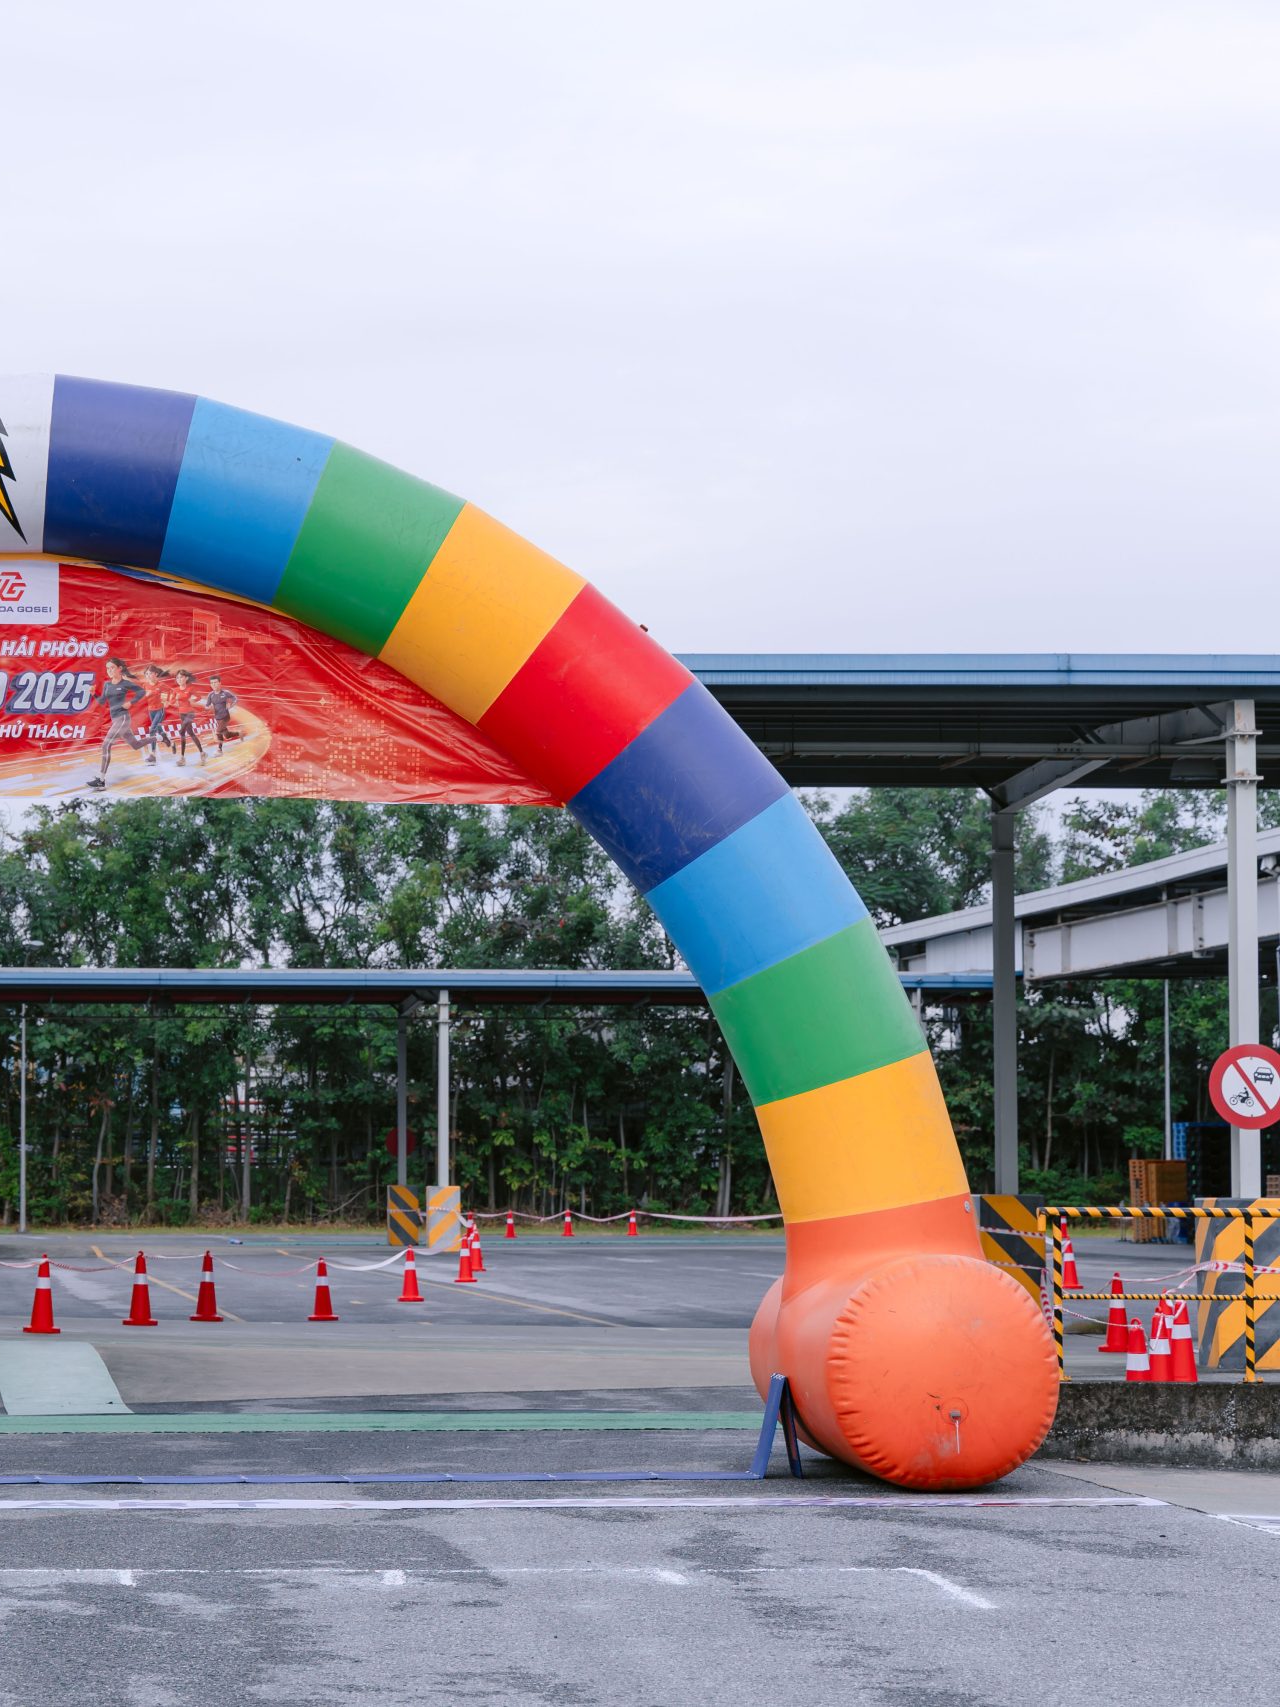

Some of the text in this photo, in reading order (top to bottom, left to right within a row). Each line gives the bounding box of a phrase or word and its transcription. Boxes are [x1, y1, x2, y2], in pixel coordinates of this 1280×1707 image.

[17, 605, 52, 613] GOSEI
[0, 635, 36, 657] HẢI
[38, 636, 109, 657] PHÒNG
[12, 671, 95, 711] 2025
[27, 720, 87, 739] THÁCH
